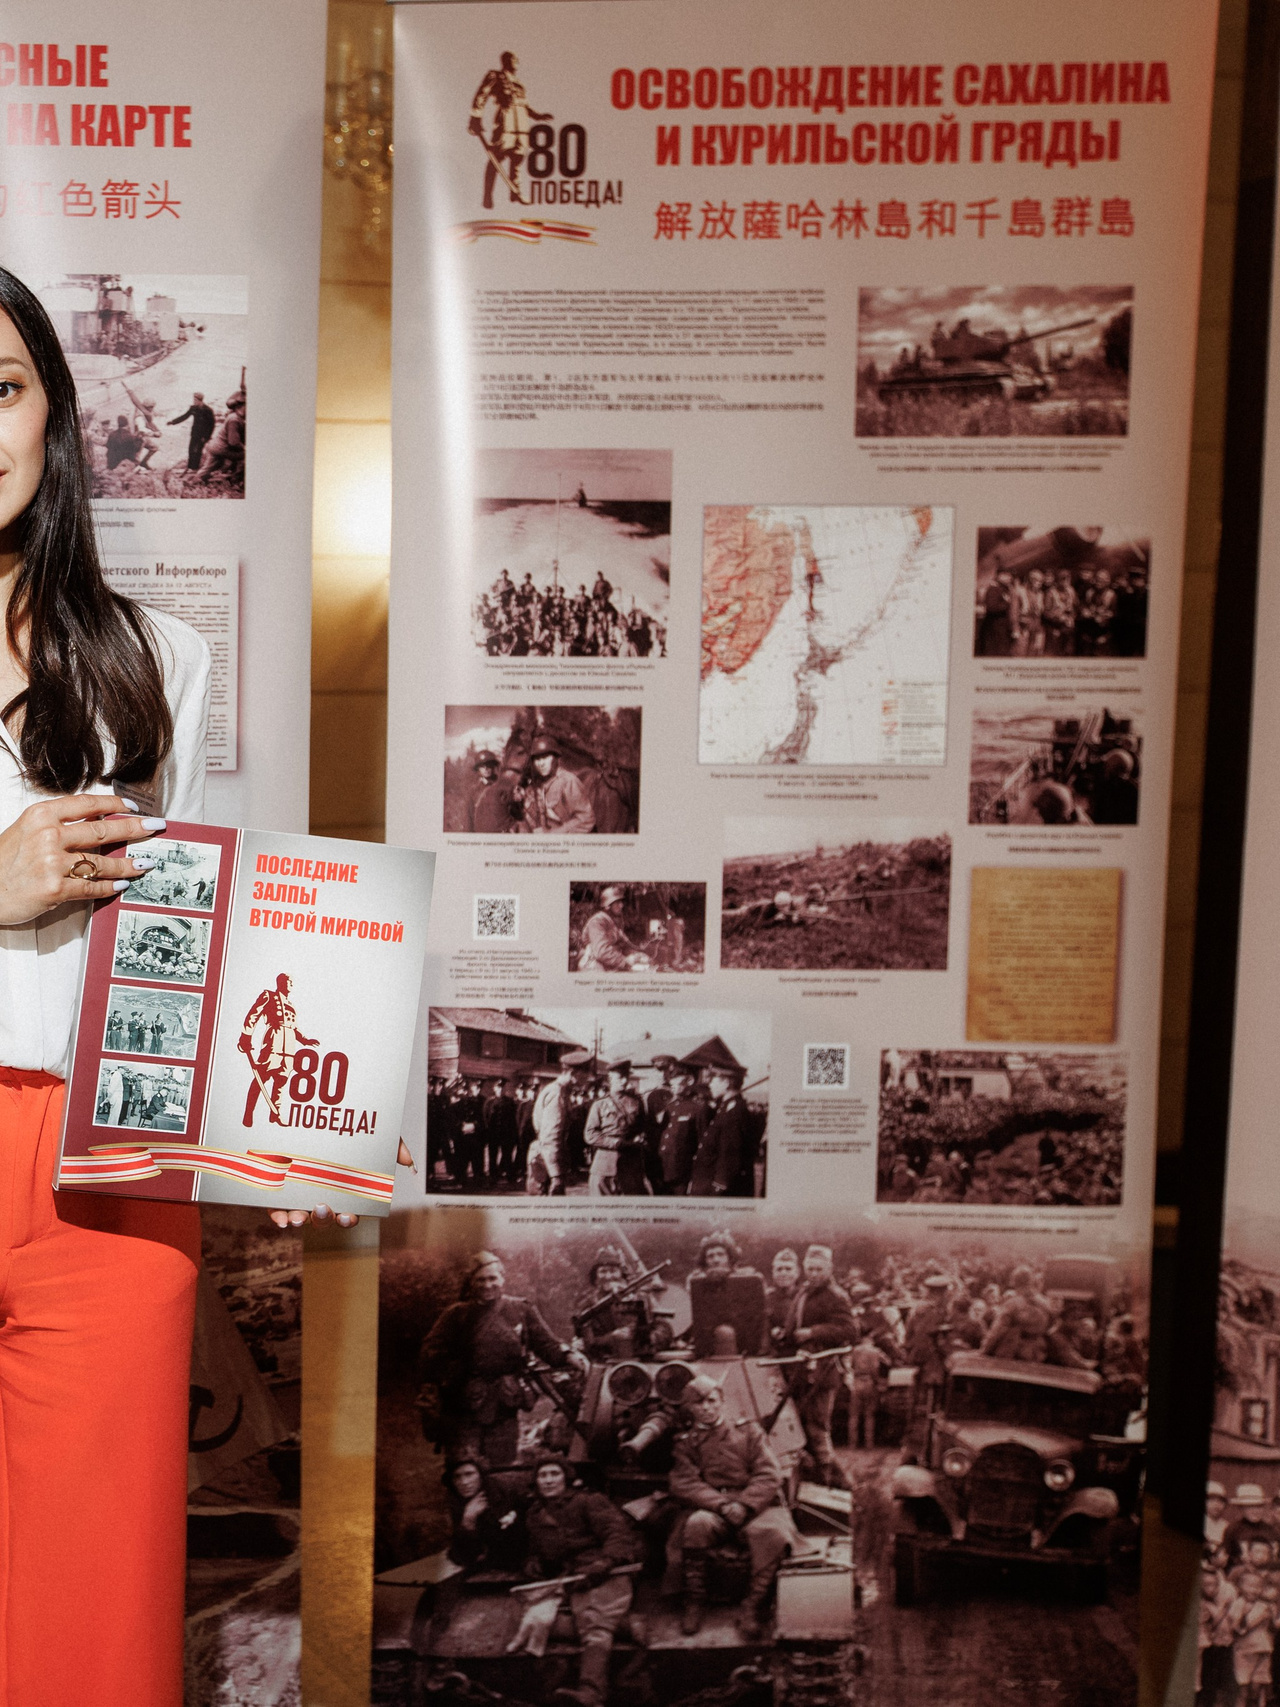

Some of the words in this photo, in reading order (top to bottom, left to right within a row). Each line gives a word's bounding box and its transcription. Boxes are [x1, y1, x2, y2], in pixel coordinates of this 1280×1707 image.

[611, 65, 943, 115] ОСВОБОЖДЕНИЕ
[954, 62, 1171, 106] САХАЛИНА
[7, 103, 60, 146] НА
[71, 104, 192, 148] КАРТЕ
[656, 126, 681, 166] И
[691, 114, 960, 166] КУРИЛЬСКОЙ
[970, 121, 1121, 169] ГРЯДЫ
[528, 124, 586, 179] 80
[530, 180, 623, 208] ПОБЕДА!
[654, 197, 1135, 241] 解放薩哈林島和千島群島
[156, 562, 226, 578] Информбюро
[256, 854, 359, 884] ПОСЛЕДНИЕ
[253, 881, 317, 906] ЗАЛПЫ
[249, 908, 317, 933] ВТОРОЙ
[320, 915, 404, 943] МИРОВОЙ
[289, 1048, 349, 1105] 80
[288, 1103, 377, 1136] ПОБЕДА!
